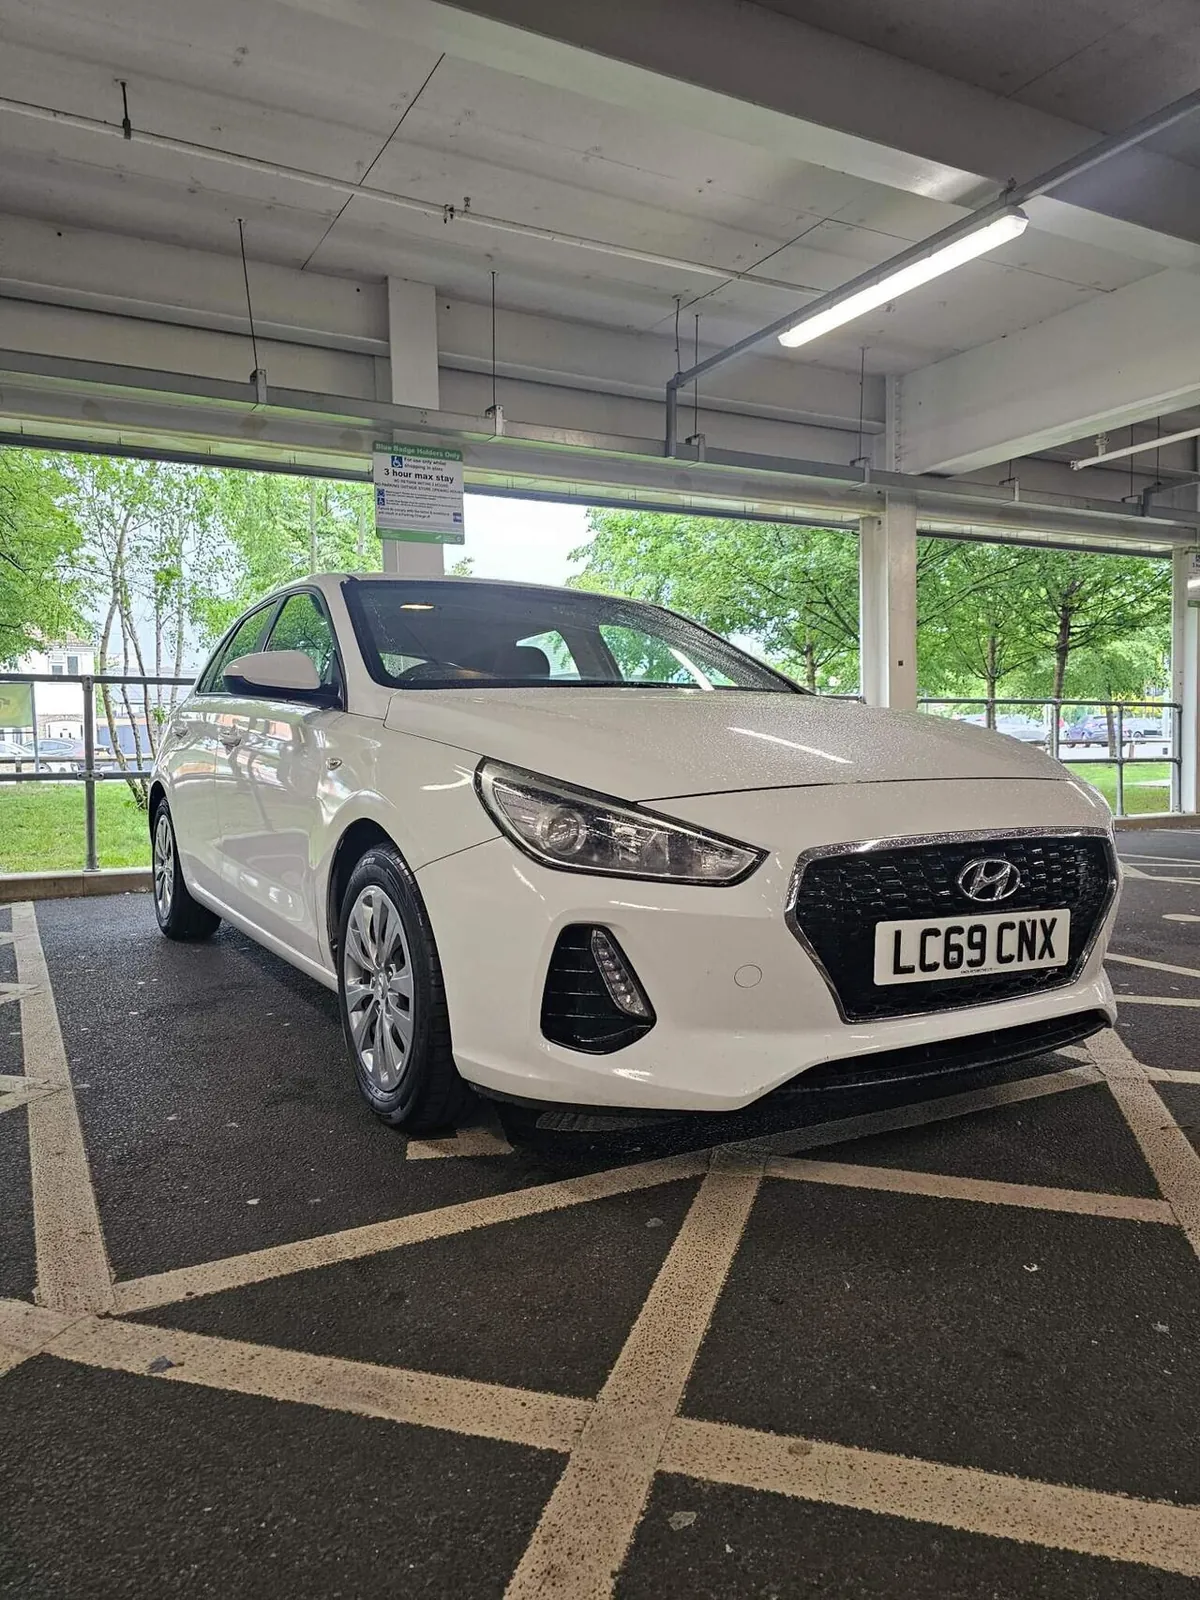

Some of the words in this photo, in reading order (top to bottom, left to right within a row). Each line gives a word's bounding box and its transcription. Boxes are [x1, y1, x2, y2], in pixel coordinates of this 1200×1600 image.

[393, 445, 415, 454] Badge
[417, 448, 443, 456] Holders
[445, 452, 460, 460] Only
[392, 469, 412, 478] hour
[436, 475, 454, 484] stay
[893, 924, 987, 975] LC69
[996, 917, 1058, 964] CNX
